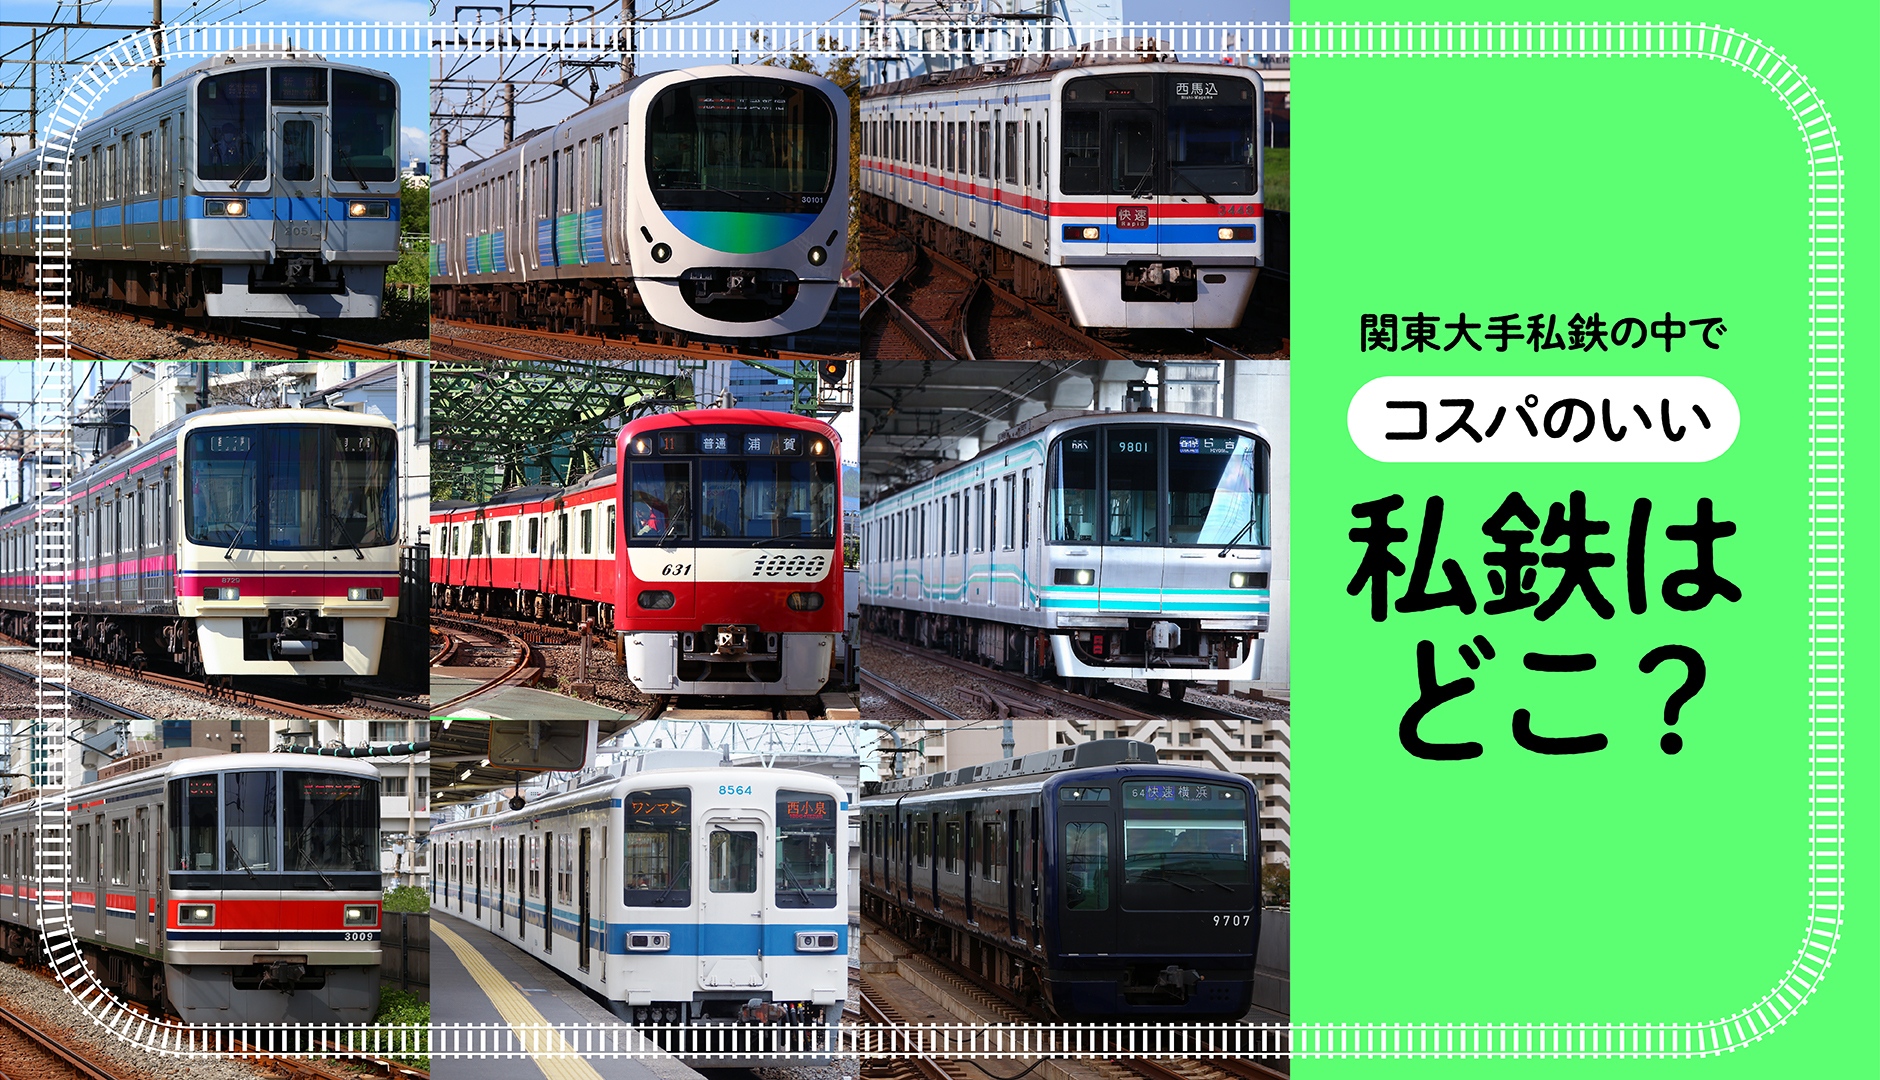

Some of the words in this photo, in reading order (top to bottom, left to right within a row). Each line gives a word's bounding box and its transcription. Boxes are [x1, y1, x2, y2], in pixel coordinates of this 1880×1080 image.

[1176, 82, 1218, 95] 西馬込
[801, 196, 823, 204] 30101
[1118, 209, 1147, 222] 快速
[664, 437, 674, 450] 11
[703, 437, 726, 449] 普通
[747, 437, 796, 451] 浦賀
[1119, 441, 1148, 452] 9801
[661, 564, 692, 576] 631
[752, 555, 825, 577] 1000
[718, 785, 753, 795] 8564
[1132, 789, 1145, 798] 64
[1147, 785, 1174, 798] 快速
[1178, 785, 1208, 799] 横浜
[632, 802, 682, 815] ワンマン
[787, 801, 827, 815] 西小泉
[1213, 915, 1250, 926] 9707
[344, 932, 373, 941] 3009
